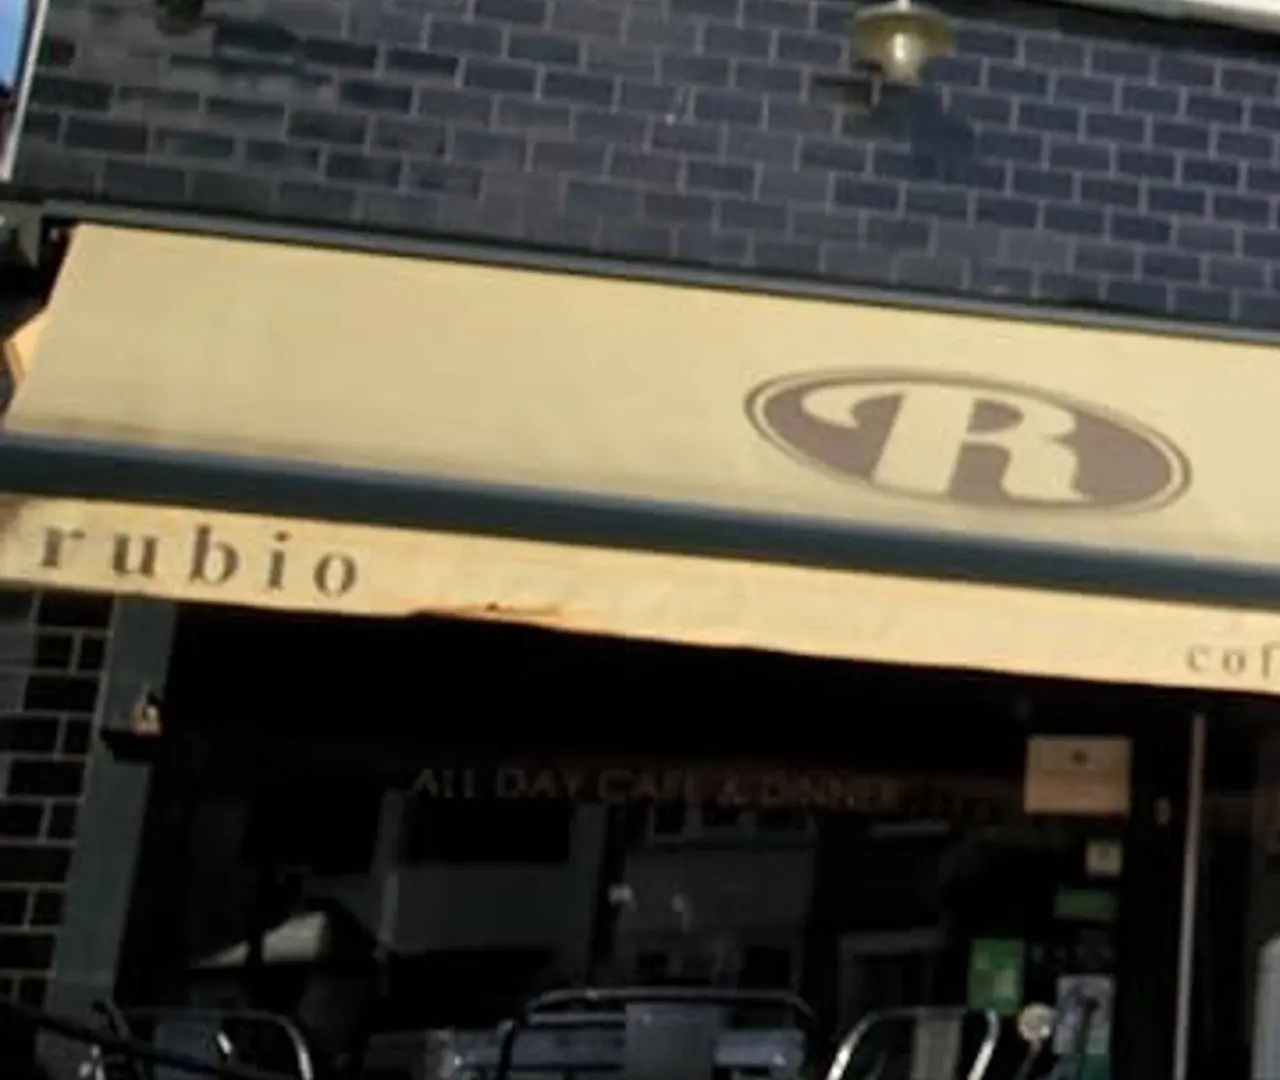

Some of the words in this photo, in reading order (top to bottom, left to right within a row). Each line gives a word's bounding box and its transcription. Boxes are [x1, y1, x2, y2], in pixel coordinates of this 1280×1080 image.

[800, 382, 1089, 499] R
[42, 523, 358, 597] rubio
[410, 768, 476, 799] ALL
[494, 768, 584, 800] DAY
